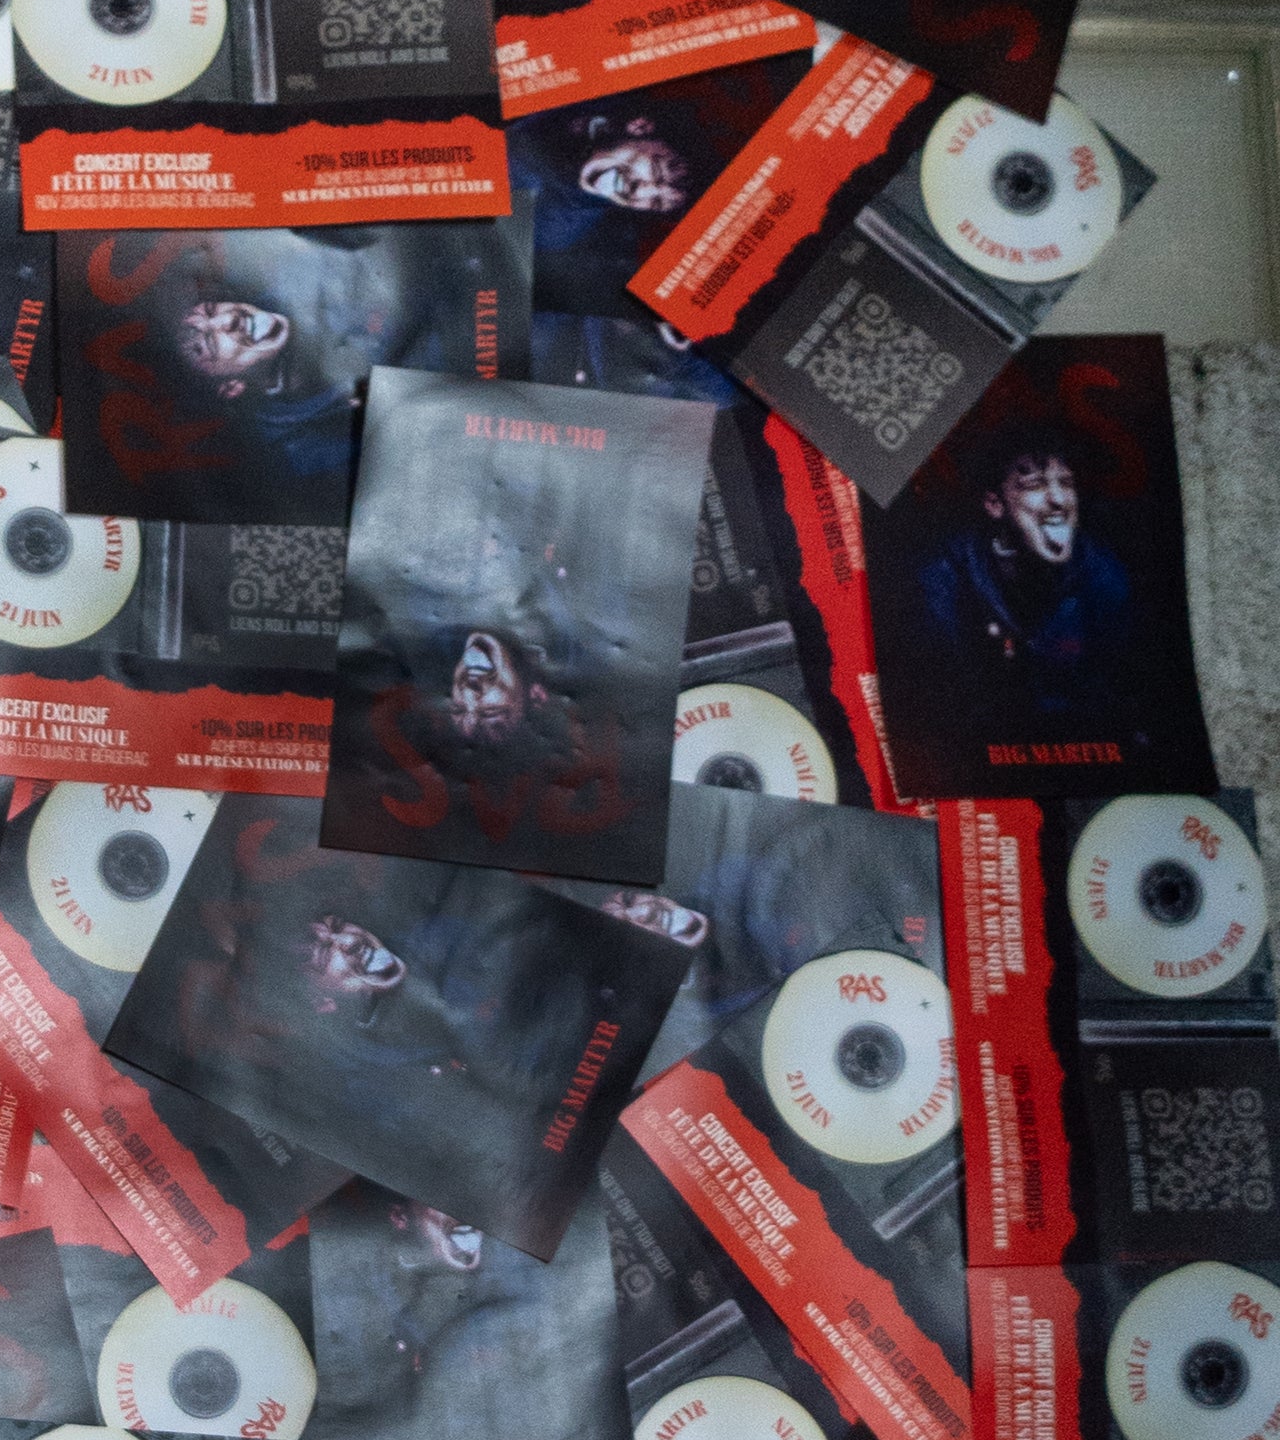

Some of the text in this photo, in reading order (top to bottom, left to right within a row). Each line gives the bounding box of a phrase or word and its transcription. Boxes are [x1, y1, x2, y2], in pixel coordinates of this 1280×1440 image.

[41, 702, 110, 725] EXCLUSIF
[23, 718, 49, 739] LA
[50, 723, 130, 748] MUSIQUE
[540, 1015, 622, 1153] BIG MARTYR
